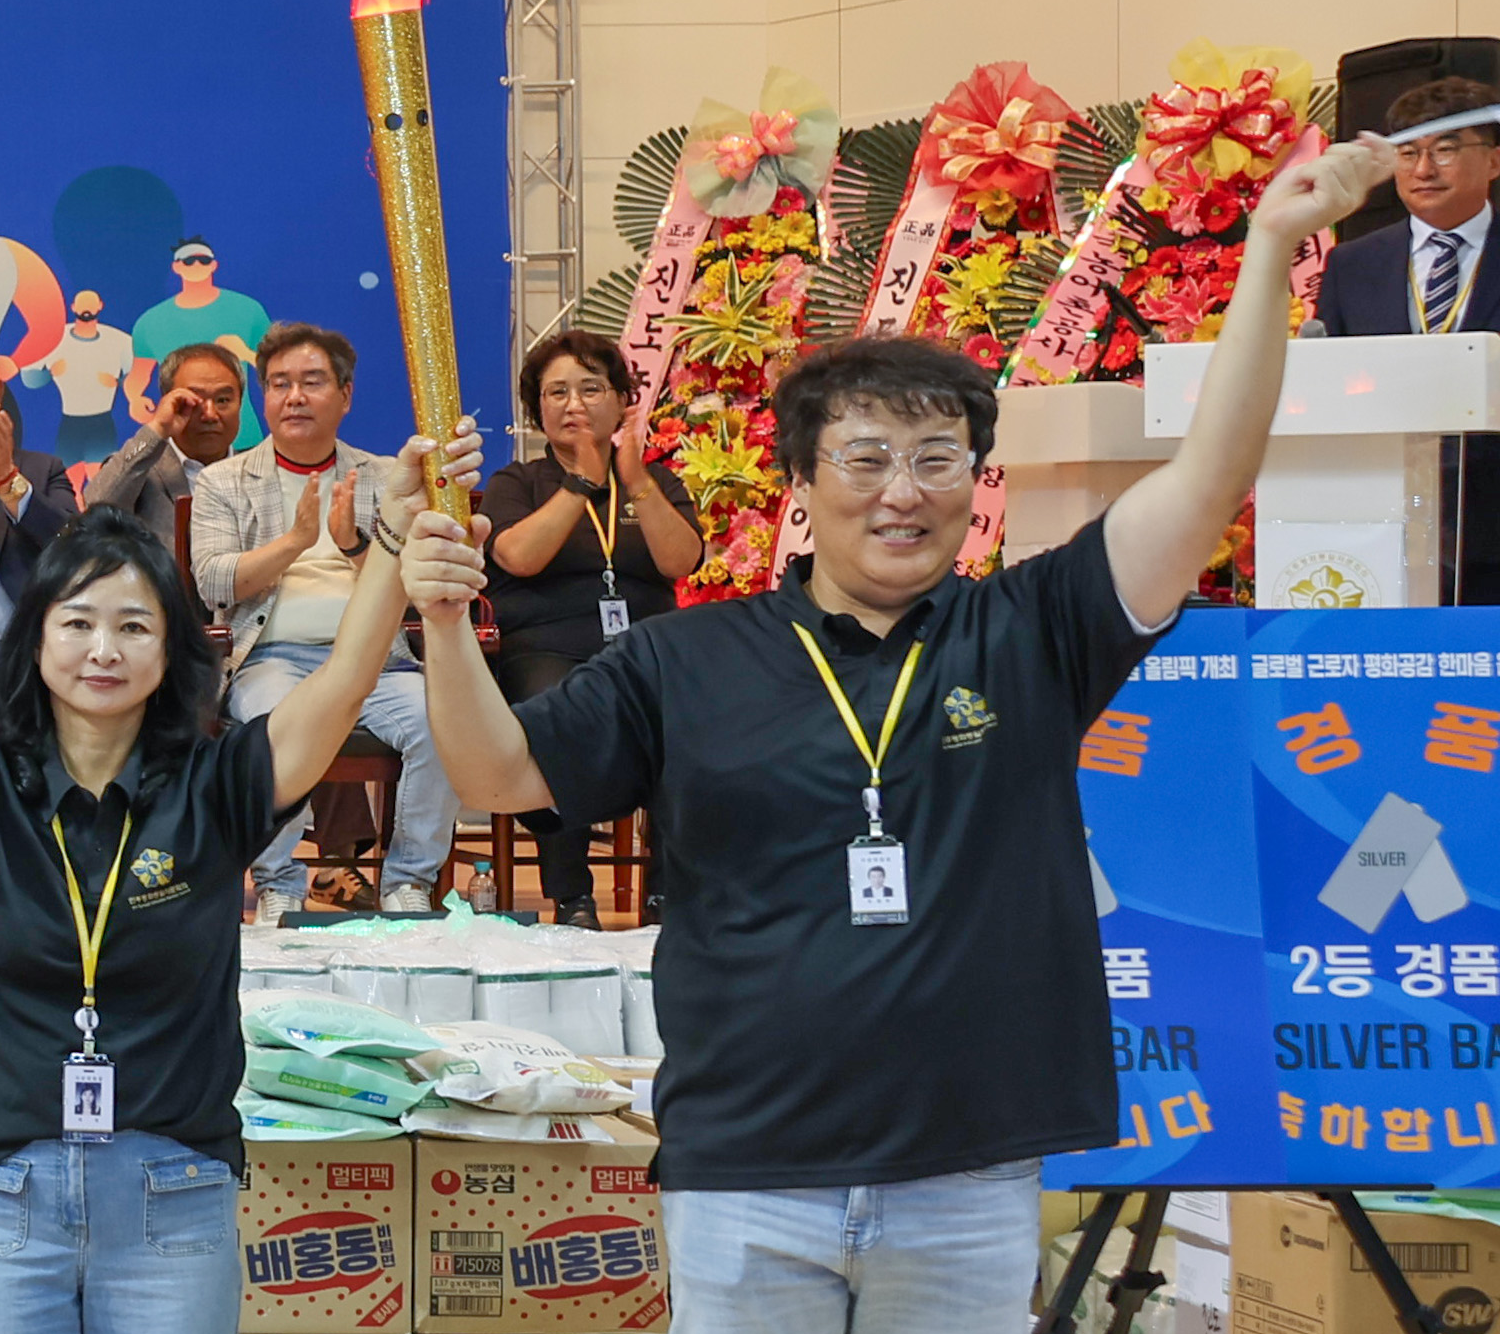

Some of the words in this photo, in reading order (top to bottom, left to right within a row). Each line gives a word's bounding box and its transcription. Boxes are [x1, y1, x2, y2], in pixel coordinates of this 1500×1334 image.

[1143, 656, 1197, 681] 올림픽
[1201, 655, 1238, 680] 개최
[1251, 655, 1304, 680] 글로벌
[1306, 654, 1360, 679] 근로자
[1363, 653, 1435, 678] 평화공감
[1438, 652, 1493, 677] 한마음
[1357, 851, 1407, 868] SILVER
[1290, 944, 1375, 999] 2등
[1394, 943, 1500, 999] 경품
[1272, 1022, 1430, 1070] SILVER
[331, 1166, 390, 1188] 멀티팩
[464, 1173, 516, 1195] 농심
[244, 1226, 379, 1285] 배홍동
[454, 1257, 501, 1274] 가5078
[509, 1229, 644, 1288] 배홍동
